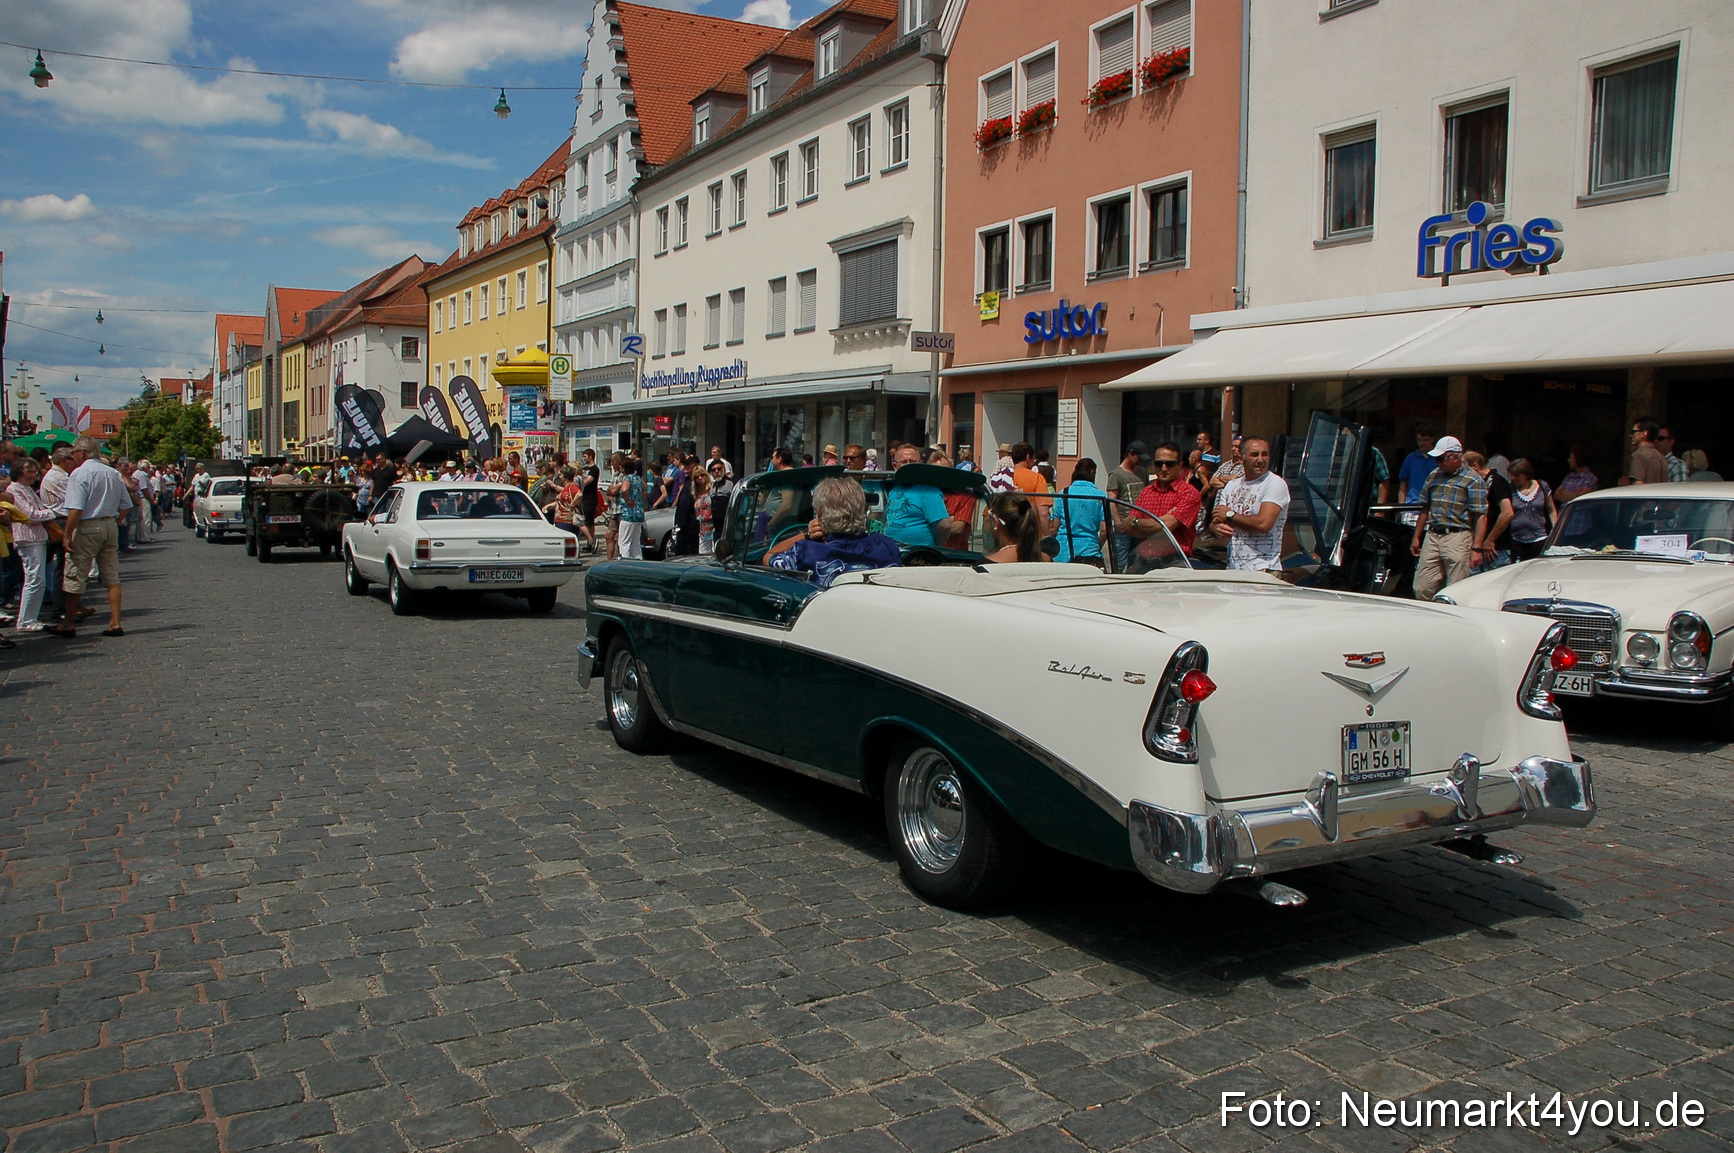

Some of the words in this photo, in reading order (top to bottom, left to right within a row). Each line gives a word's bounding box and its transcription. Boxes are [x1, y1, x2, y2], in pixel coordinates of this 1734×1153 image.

[1417, 200, 1564, 278] fries
[641, 367, 698, 389] Buchhandlung
[697, 358, 748, 388] Rupprecht
[1660, 539, 1681, 549] 304
[475, 570, 486, 580] NM
[490, 570, 500, 580] EC
[1047, 660, 1080, 676] Bel
[1079, 666, 1112, 682] Air
[1369, 730, 1378, 749] N
[1351, 752, 1368, 771] GM
[1372, 749, 1389, 768] 56
[1393, 748, 1402, 767] H
[1362, 771, 1394, 780] CHEVROLET
